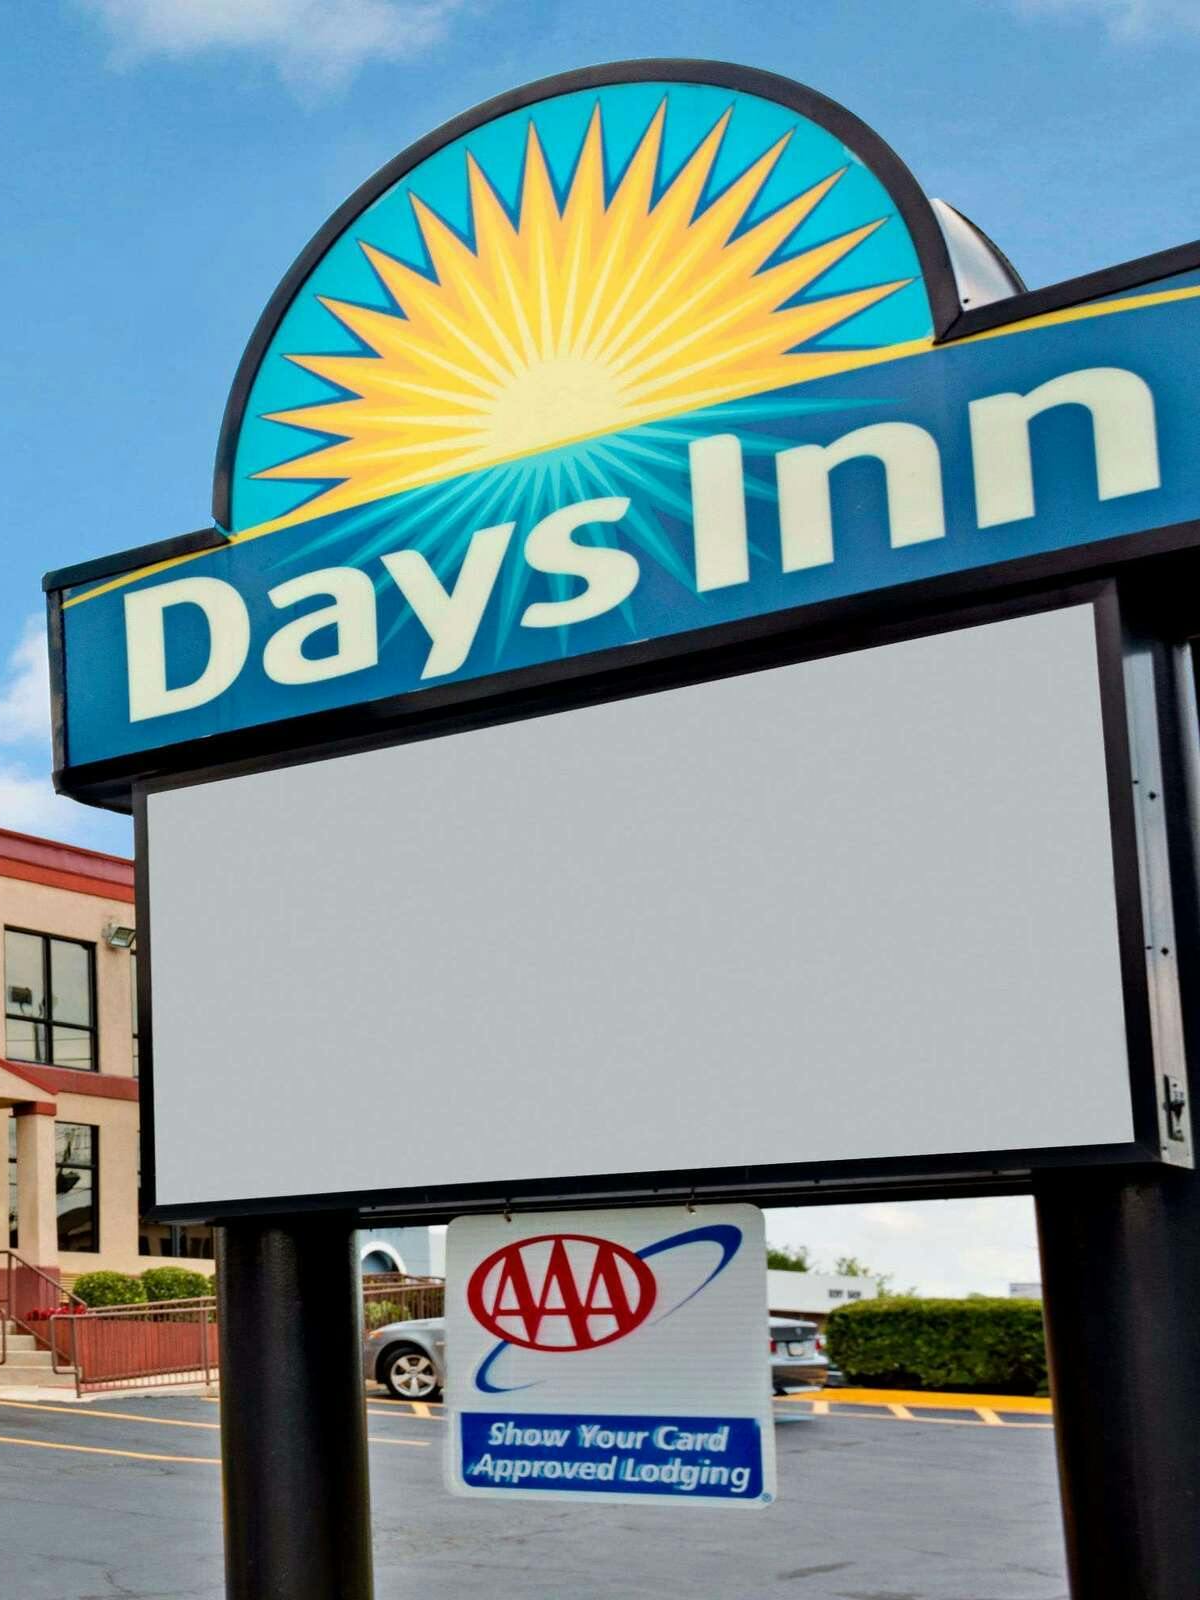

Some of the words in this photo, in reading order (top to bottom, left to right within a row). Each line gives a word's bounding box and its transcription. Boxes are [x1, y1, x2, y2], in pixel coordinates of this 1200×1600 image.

[123, 495, 640, 723] Days
[689, 367, 1161, 593] Inn
[488, 1236, 638, 1350] AAA
[466, 1453, 617, 1483] Approved
[620, 1457, 752, 1492] Lodging
[488, 1421, 570, 1447] Show
[578, 1423, 650, 1450] Your
[654, 1425, 730, 1453] Card
